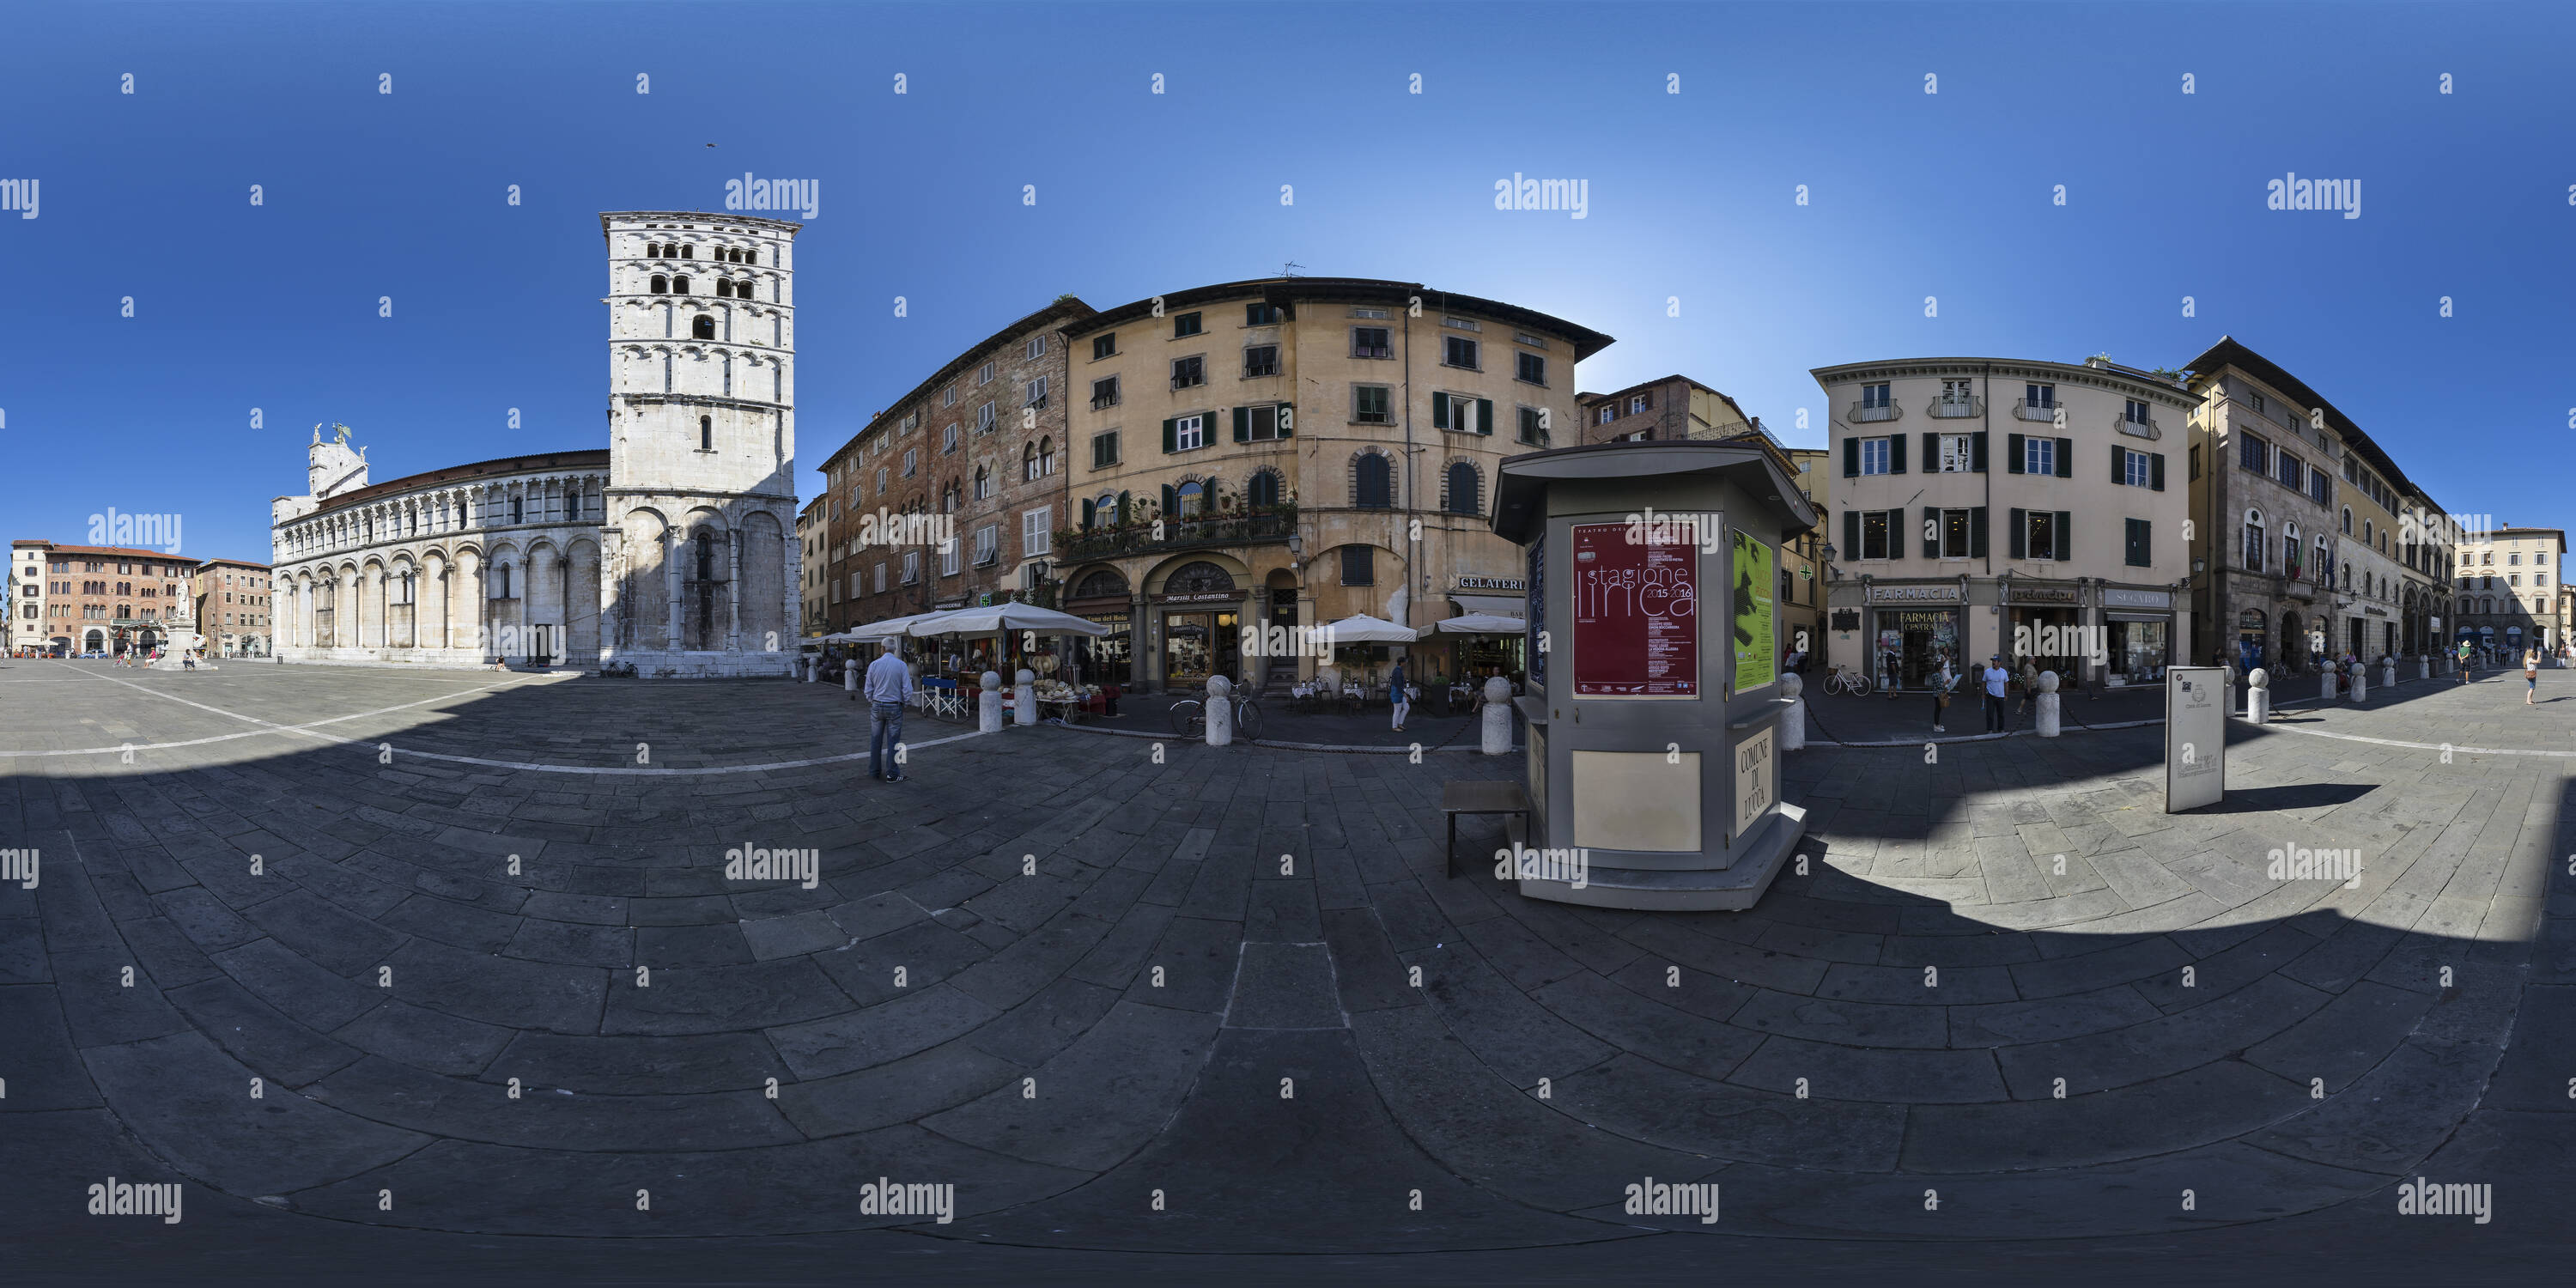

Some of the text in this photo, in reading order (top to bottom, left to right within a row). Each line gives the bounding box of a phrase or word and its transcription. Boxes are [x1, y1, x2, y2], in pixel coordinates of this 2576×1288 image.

[1461, 577, 1525, 590] GELATERI
[1588, 562, 1689, 590] stagione
[1577, 570, 1694, 617] lirica
[1647, 588, 1692, 598] 2015-2016
[1873, 587, 1958, 600] FARMACIA
[1899, 612, 1949, 623] FARMACIA
[1905, 623, 1943, 631] CENTRALE
[1741, 738, 1768, 774] COMUNE
[1752, 768, 1759, 791] DI
[1744, 785, 1765, 821] LUCCA
